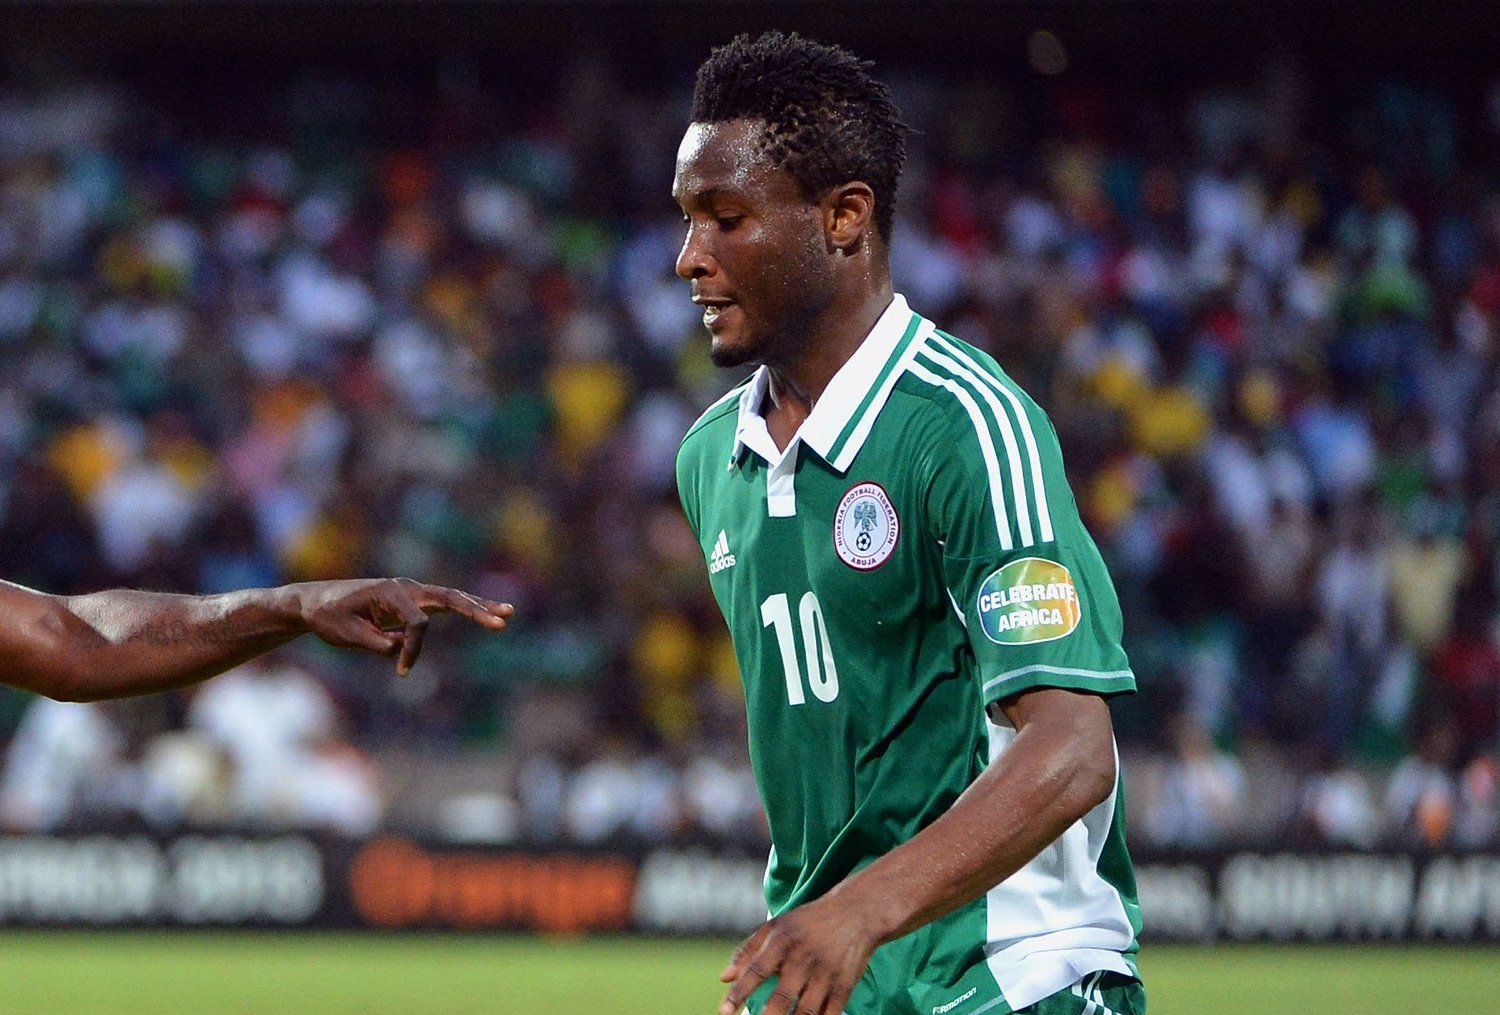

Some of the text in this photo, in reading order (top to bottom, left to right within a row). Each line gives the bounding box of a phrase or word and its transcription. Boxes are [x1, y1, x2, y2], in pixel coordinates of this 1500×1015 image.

[836, 487, 896, 547] NIGERIA FOOTBALL FEDERATION
[850, 556, 877, 566] ABUJA
[980, 582, 1076, 613] CELEBRATE
[998, 608, 1064, 633] AFRICA
[760, 591, 840, 706] 10
